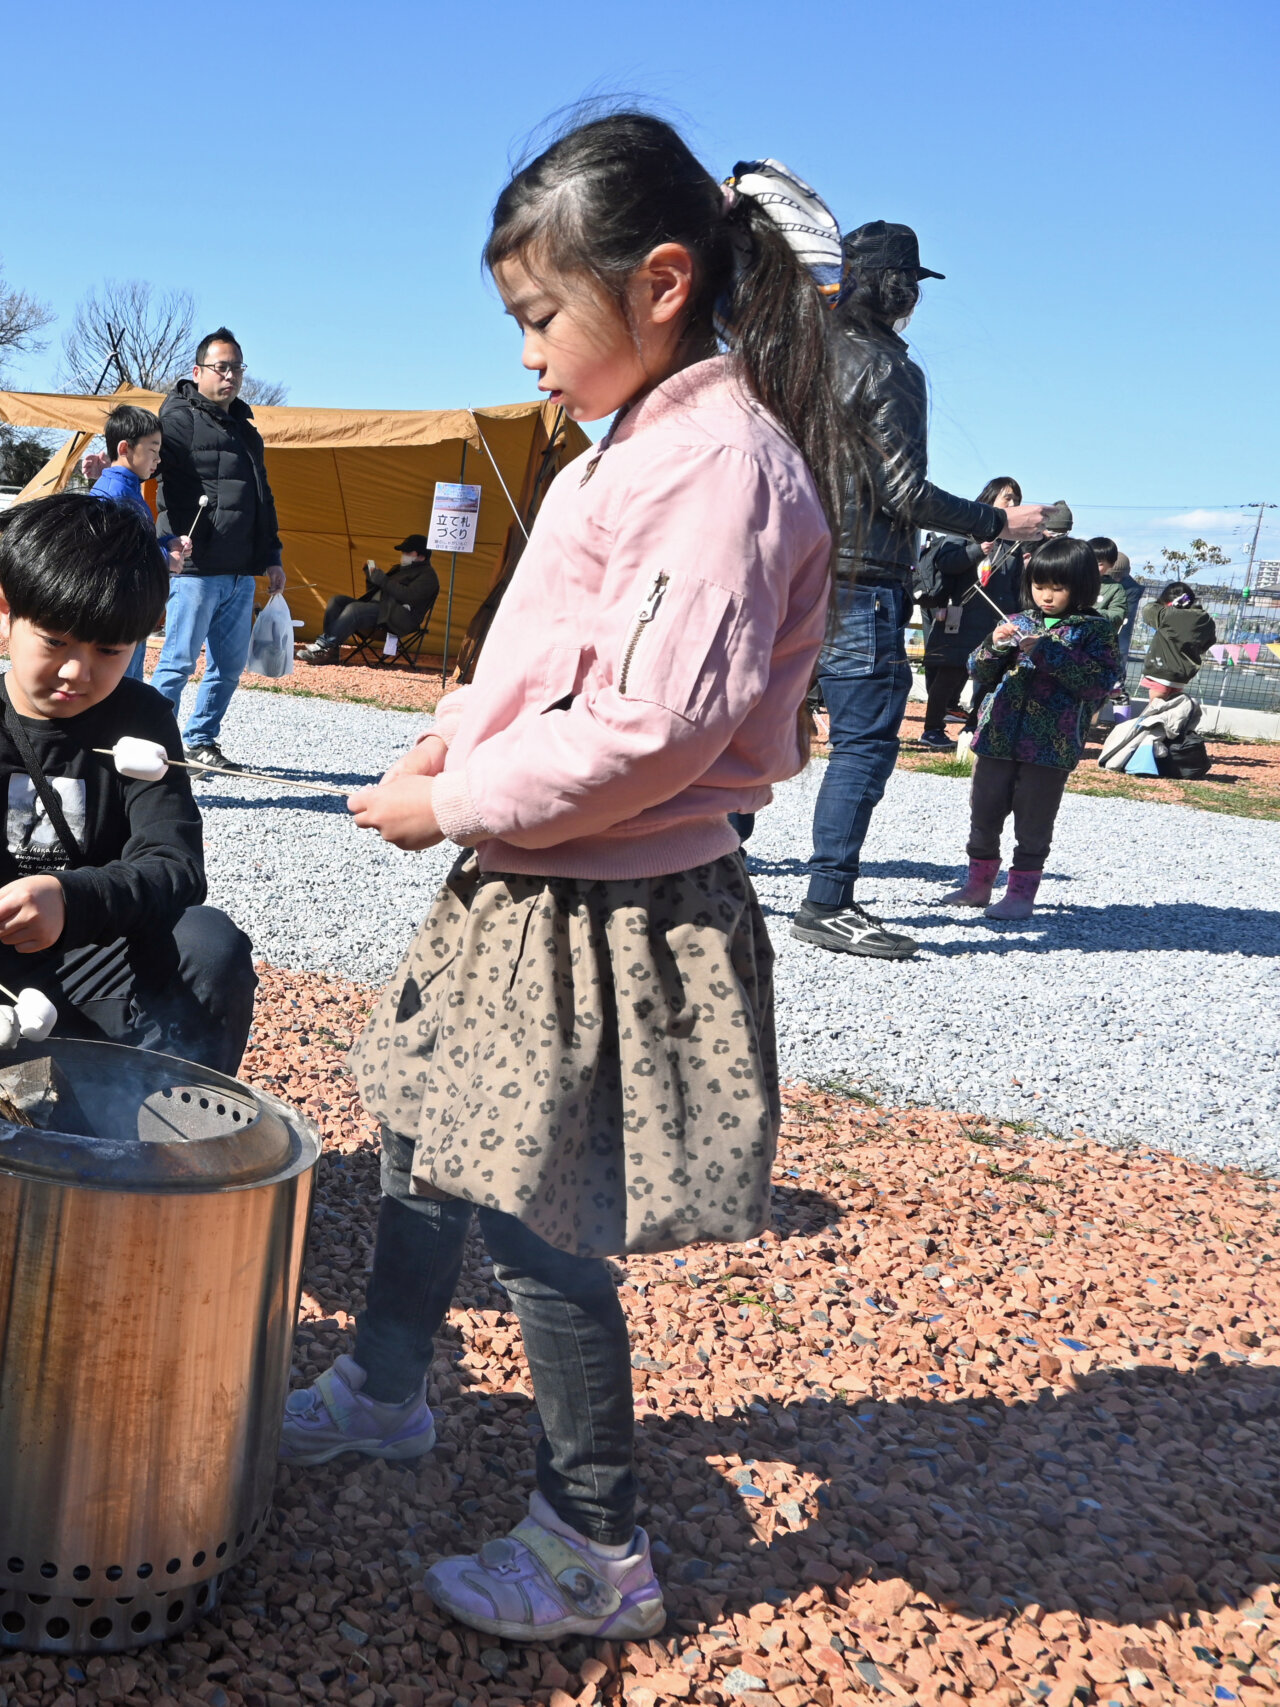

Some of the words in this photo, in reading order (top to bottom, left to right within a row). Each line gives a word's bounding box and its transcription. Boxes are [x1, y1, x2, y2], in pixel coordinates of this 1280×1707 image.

[436, 514, 470, 527] 立て札
[437, 527, 467, 540] づくり
